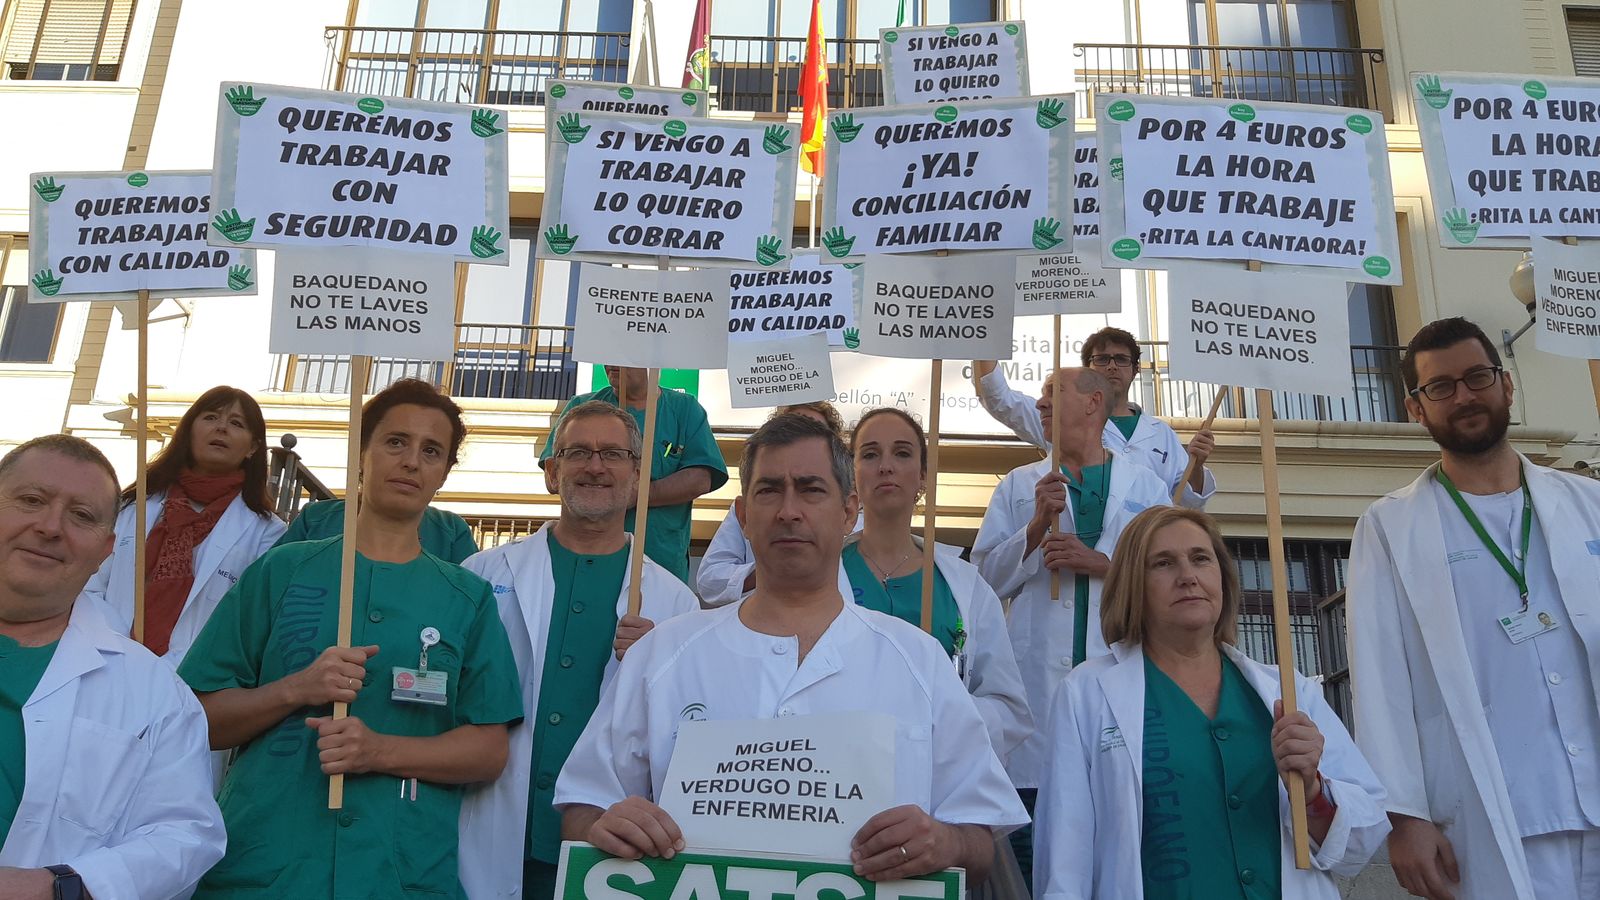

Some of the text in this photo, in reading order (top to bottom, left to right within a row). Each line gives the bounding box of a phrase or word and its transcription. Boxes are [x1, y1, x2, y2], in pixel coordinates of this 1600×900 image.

[908, 33, 998, 51] SI VENGO A
[914, 54, 998, 71] TRABAJAR
[915, 74, 999, 94] LO QUIERO
[1454, 98, 1512, 120] POR
[1523, 100, 1538, 119] 4
[1547, 100, 1600, 122] EUR
[278, 107, 453, 142] QUEREMOS
[875, 118, 1013, 149] QUEREMOS
[1138, 118, 1206, 141] POR
[1216, 120, 1236, 140] 4
[1248, 122, 1346, 149] EUROS
[596, 131, 625, 149] SI
[635, 133, 724, 154] VENGO
[730, 138, 749, 157] A
[1492, 134, 1526, 155] LA
[280, 142, 451, 176] TRABAJAR
[1176, 155, 1315, 183] LA HORA
[600, 160, 745, 190] TRABAJAR
[902, 152, 979, 188] ¡YA!
[333, 180, 398, 204] CON
[1468, 170, 1521, 197] QUE
[75, 196, 210, 221] QUEREMOS
[594, 192, 742, 219] LO QUIERO
[852, 182, 1031, 217] CONCILIACIÓN
[1143, 189, 1355, 227] QUE TRABAJE
[1530, 208, 1552, 223] LA
[78, 223, 208, 246] TRABAJAR
[264, 213, 457, 246] SEGURIDAD
[608, 225, 724, 250] COBRAR
[876, 222, 1002, 246] FAMILIAR
[1207, 231, 1233, 246] LA
[1242, 231, 1366, 255] CANTAORA!
[59, 250, 232, 274] CON CALIDAD
[1040, 256, 1081, 265] MIGUEL
[730, 271, 832, 290] QUEREMOS
[1032, 267, 1089, 278] MORENO...
[1554, 268, 1600, 283] MIGUE
[293, 275, 427, 294] BAQUEDANO
[877, 283, 994, 299] BAQUEDANO
[1016, 280, 1070, 290] VERDUGO
[1074, 279, 1088, 287] DE
[291, 295, 428, 314] NO TE LAVES
[589, 287, 713, 303] GERENTE BAENA
[731, 293, 832, 311] TRABAJAR
[1024, 290, 1098, 301] ENFERMERIA.
[595, 303, 704, 318] TUGESTION DA
[874, 302, 993, 318] NO TE LAVES
[1191, 299, 1316, 325] BAQUEDANO
[1542, 296, 1596, 318] VERDUGO
[297, 316, 421, 333] LAS MANOS
[626, 321, 671, 334] PENA.
[729, 315, 845, 332] ON CALIDAD
[879, 323, 987, 338] LAS MANOS
[1192, 319, 1316, 344] NO TE LAVES
[1547, 318, 1600, 336] ENFERM
[757, 353, 794, 363] MIGUEL
[1196, 340, 1315, 365] LAS MANOS.
[737, 370, 819, 384] VERDUGO DE LA
[750, 363, 803, 374] MORENO...
[1000, 361, 1054, 382] Mál
[736, 739, 816, 755] MIGUEL
[716, 757, 831, 774] MORENO...
[681, 779, 863, 799] VERDUGO DE LA
[692, 800, 845, 824] ENFERMERIA.
